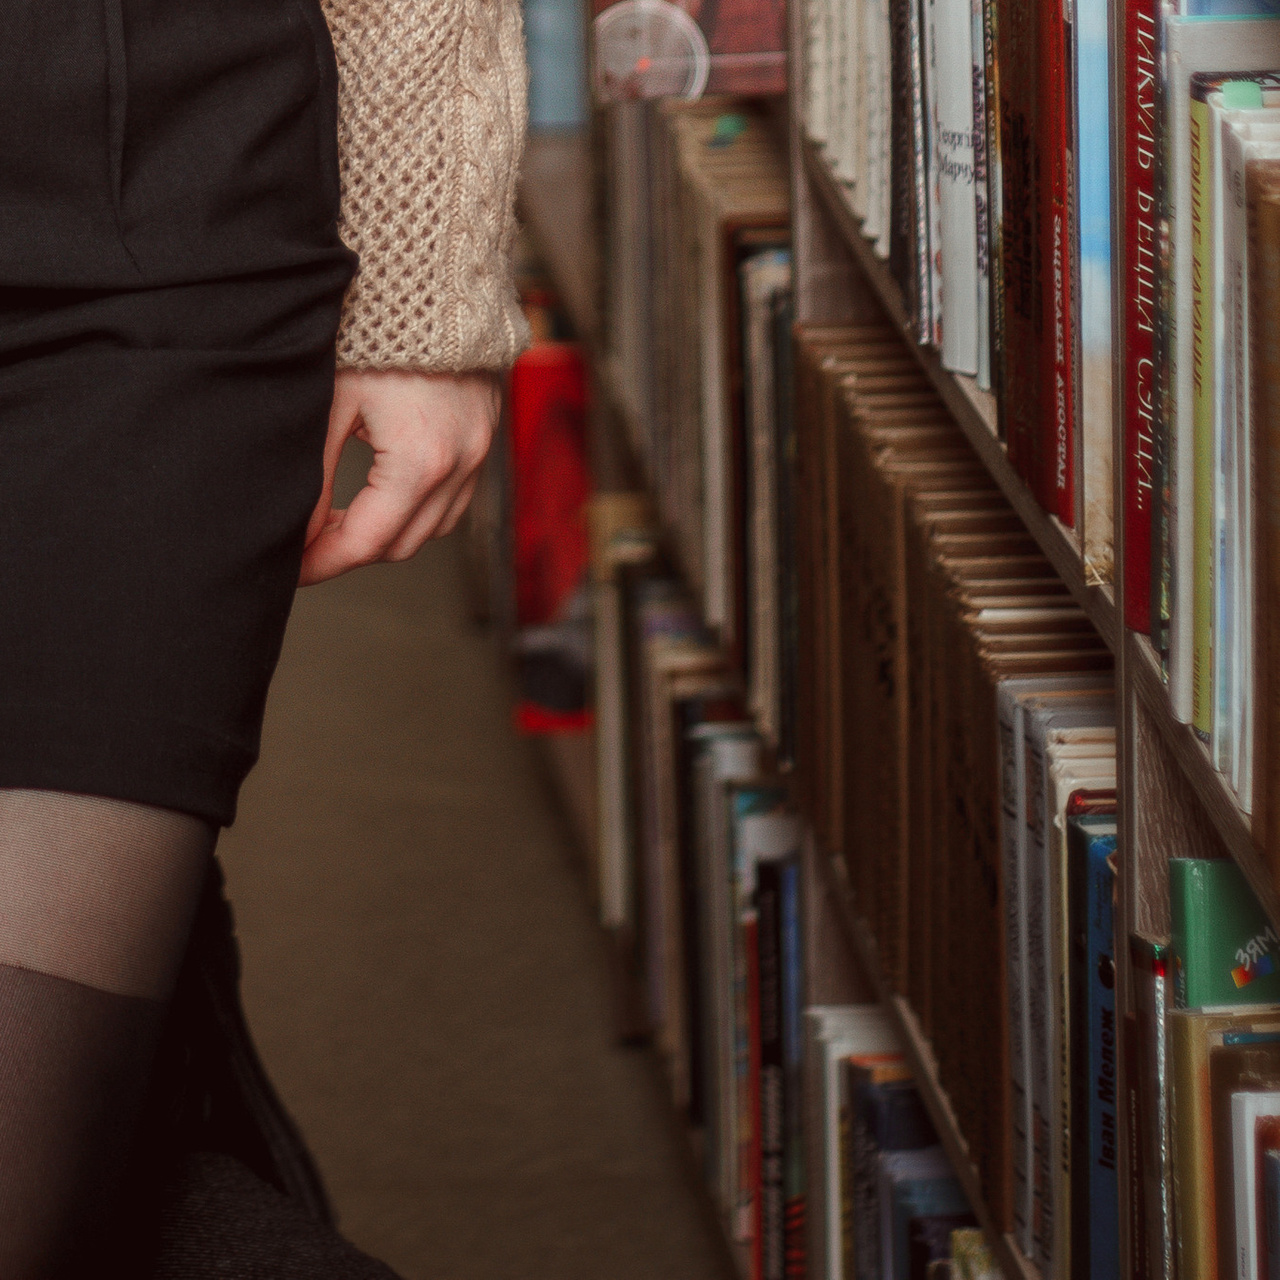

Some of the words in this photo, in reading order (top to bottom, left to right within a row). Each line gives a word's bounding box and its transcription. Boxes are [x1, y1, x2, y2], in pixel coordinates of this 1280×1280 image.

[1137, 11, 1155, 170] ПАКУЛЬ
[1191, 116, 1201, 246] ПЕРШАЕ
[1192, 254, 1202, 399] КАХАННЕ
[1096, 1004, 1115, 1106] Мележ
[1098, 1110, 1116, 1171] Іван
